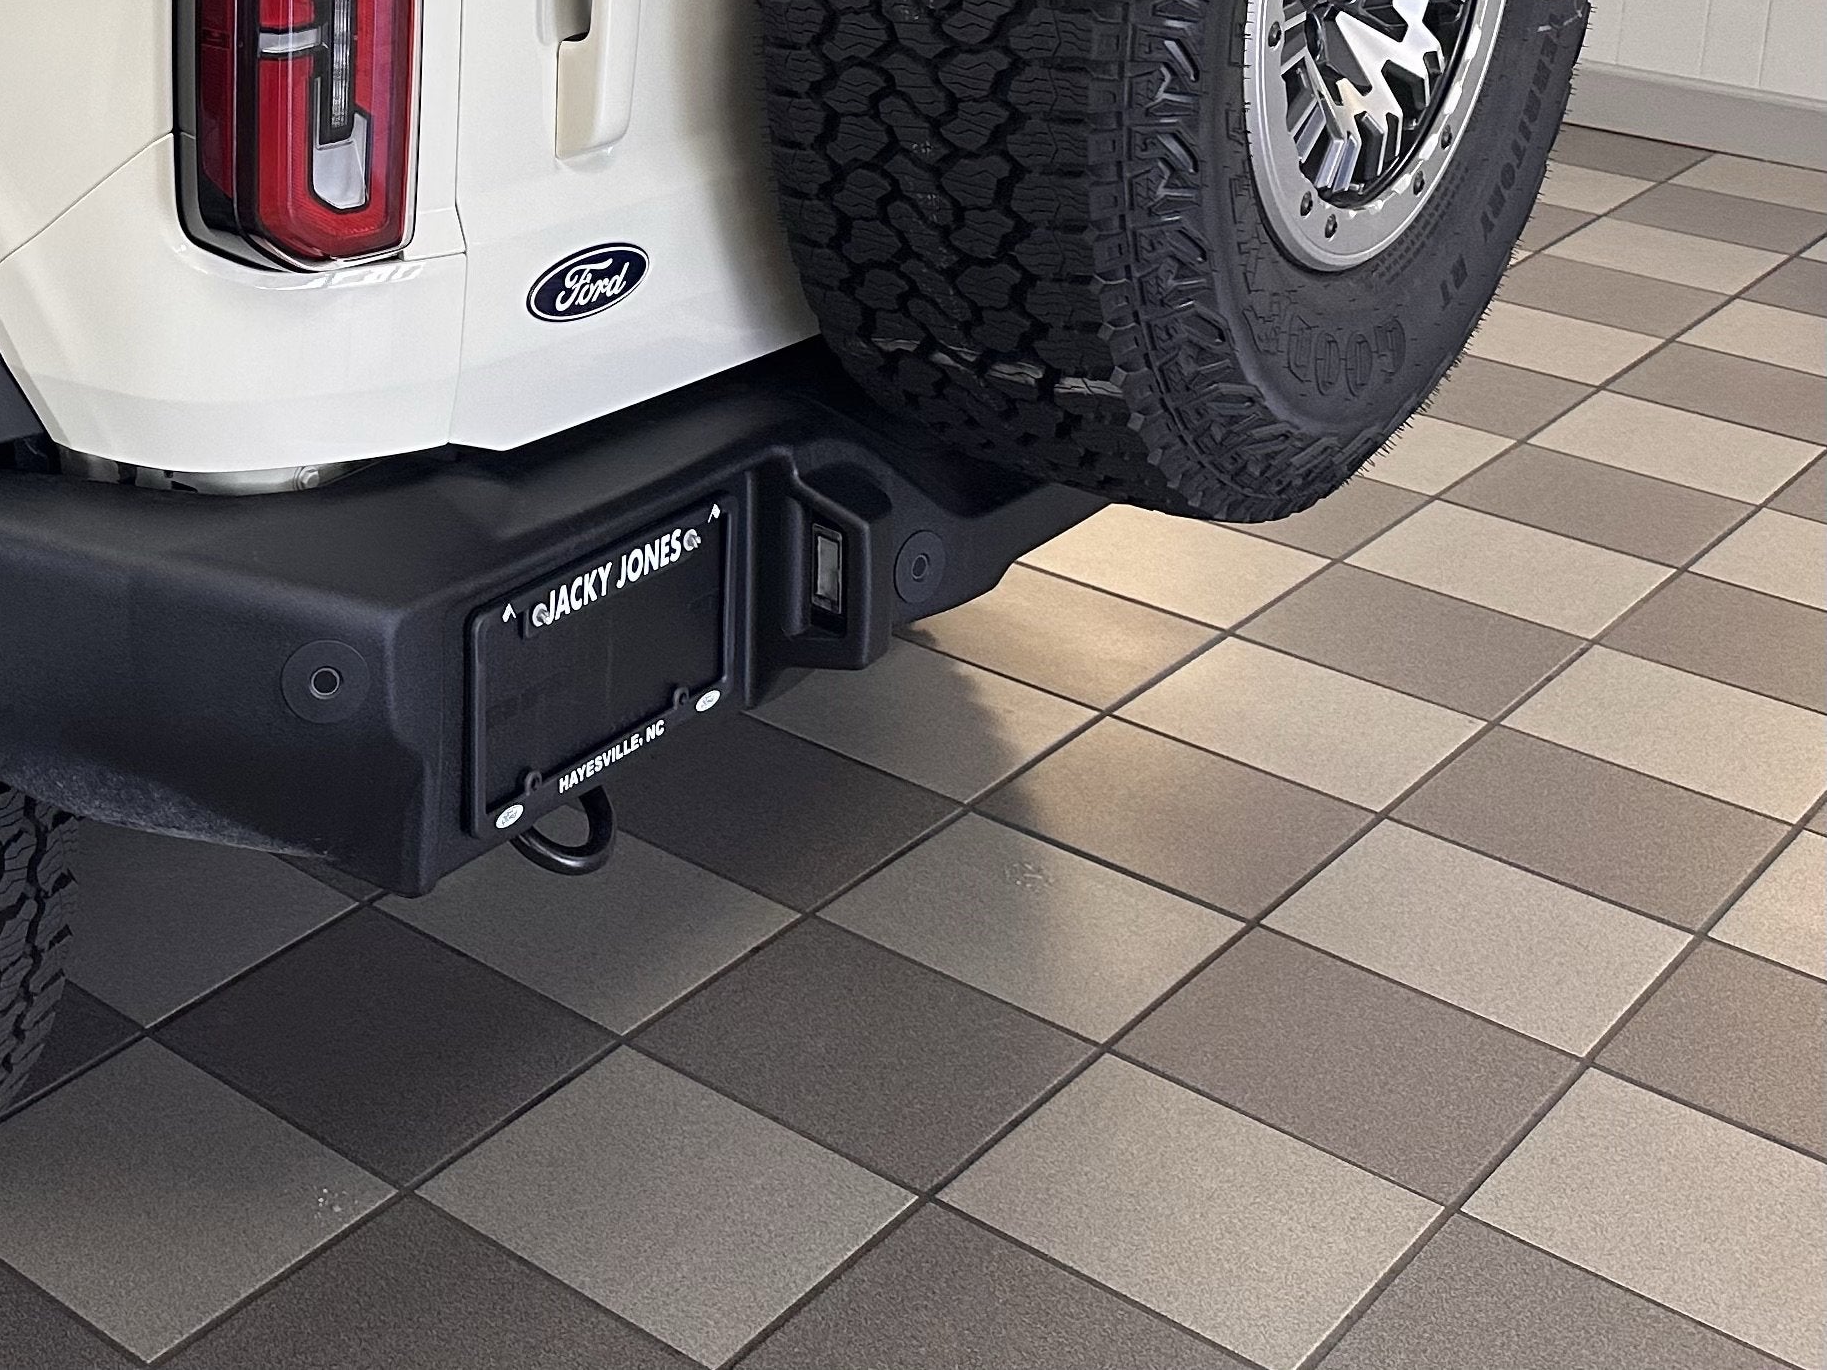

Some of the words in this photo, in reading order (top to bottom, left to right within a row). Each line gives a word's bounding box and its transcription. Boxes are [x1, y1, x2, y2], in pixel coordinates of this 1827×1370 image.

[555, 258, 629, 311] Ford
[545, 562, 613, 626] JACKY
[616, 529, 682, 589] JONES
[559, 733, 644, 794] HAYESVILLE,
[646, 719, 666, 743] NC
